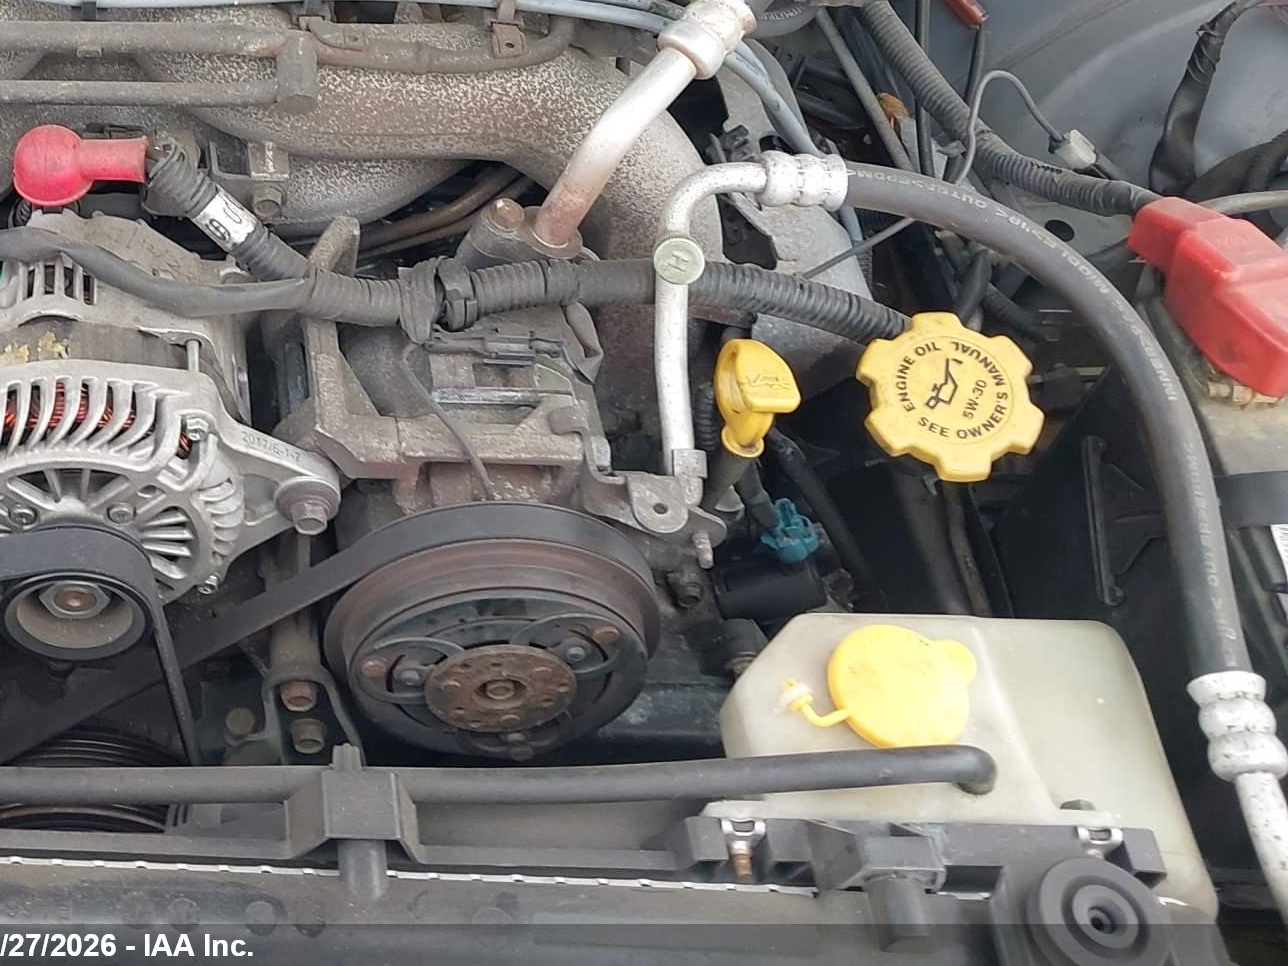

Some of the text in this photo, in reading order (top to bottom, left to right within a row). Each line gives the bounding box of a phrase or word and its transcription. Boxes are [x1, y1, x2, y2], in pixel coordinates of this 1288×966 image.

[896, 341, 941, 412] ENGINE OIL
[918, 341, 1009, 440] SEE OWNER'S MANUAL
[962, 379, 987, 420] 5W-30
